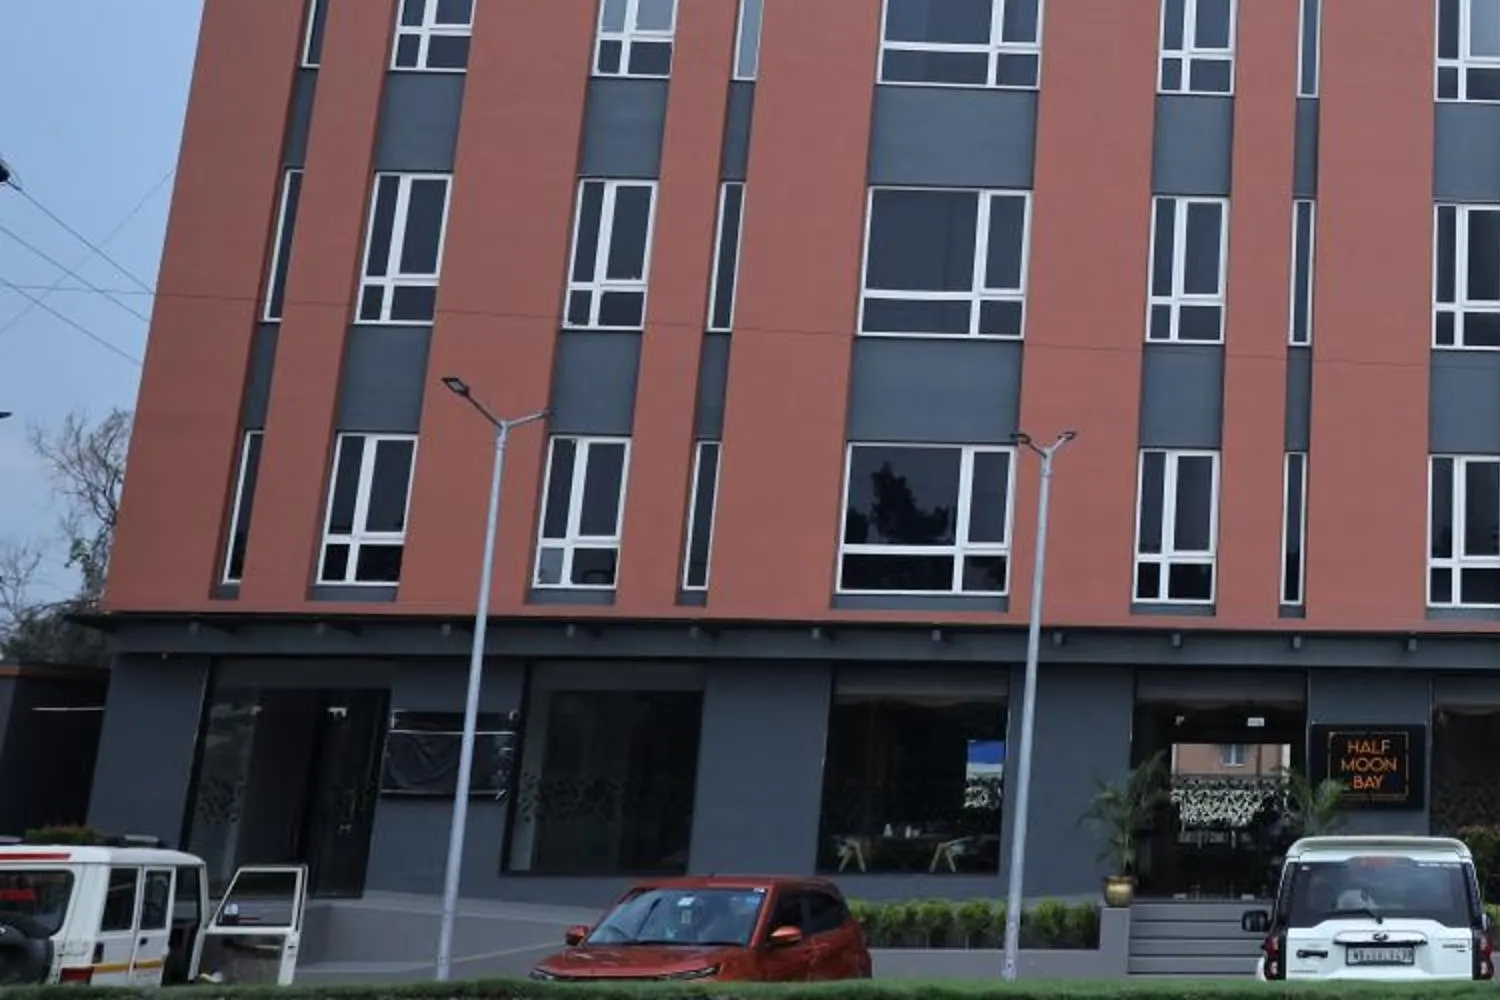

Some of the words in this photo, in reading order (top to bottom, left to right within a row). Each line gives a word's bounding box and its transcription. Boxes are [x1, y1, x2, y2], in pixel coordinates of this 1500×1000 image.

[1347, 739, 1390, 753] HALF
[1341, 756, 1398, 771] MOON
[1353, 774, 1384, 790] BAY
